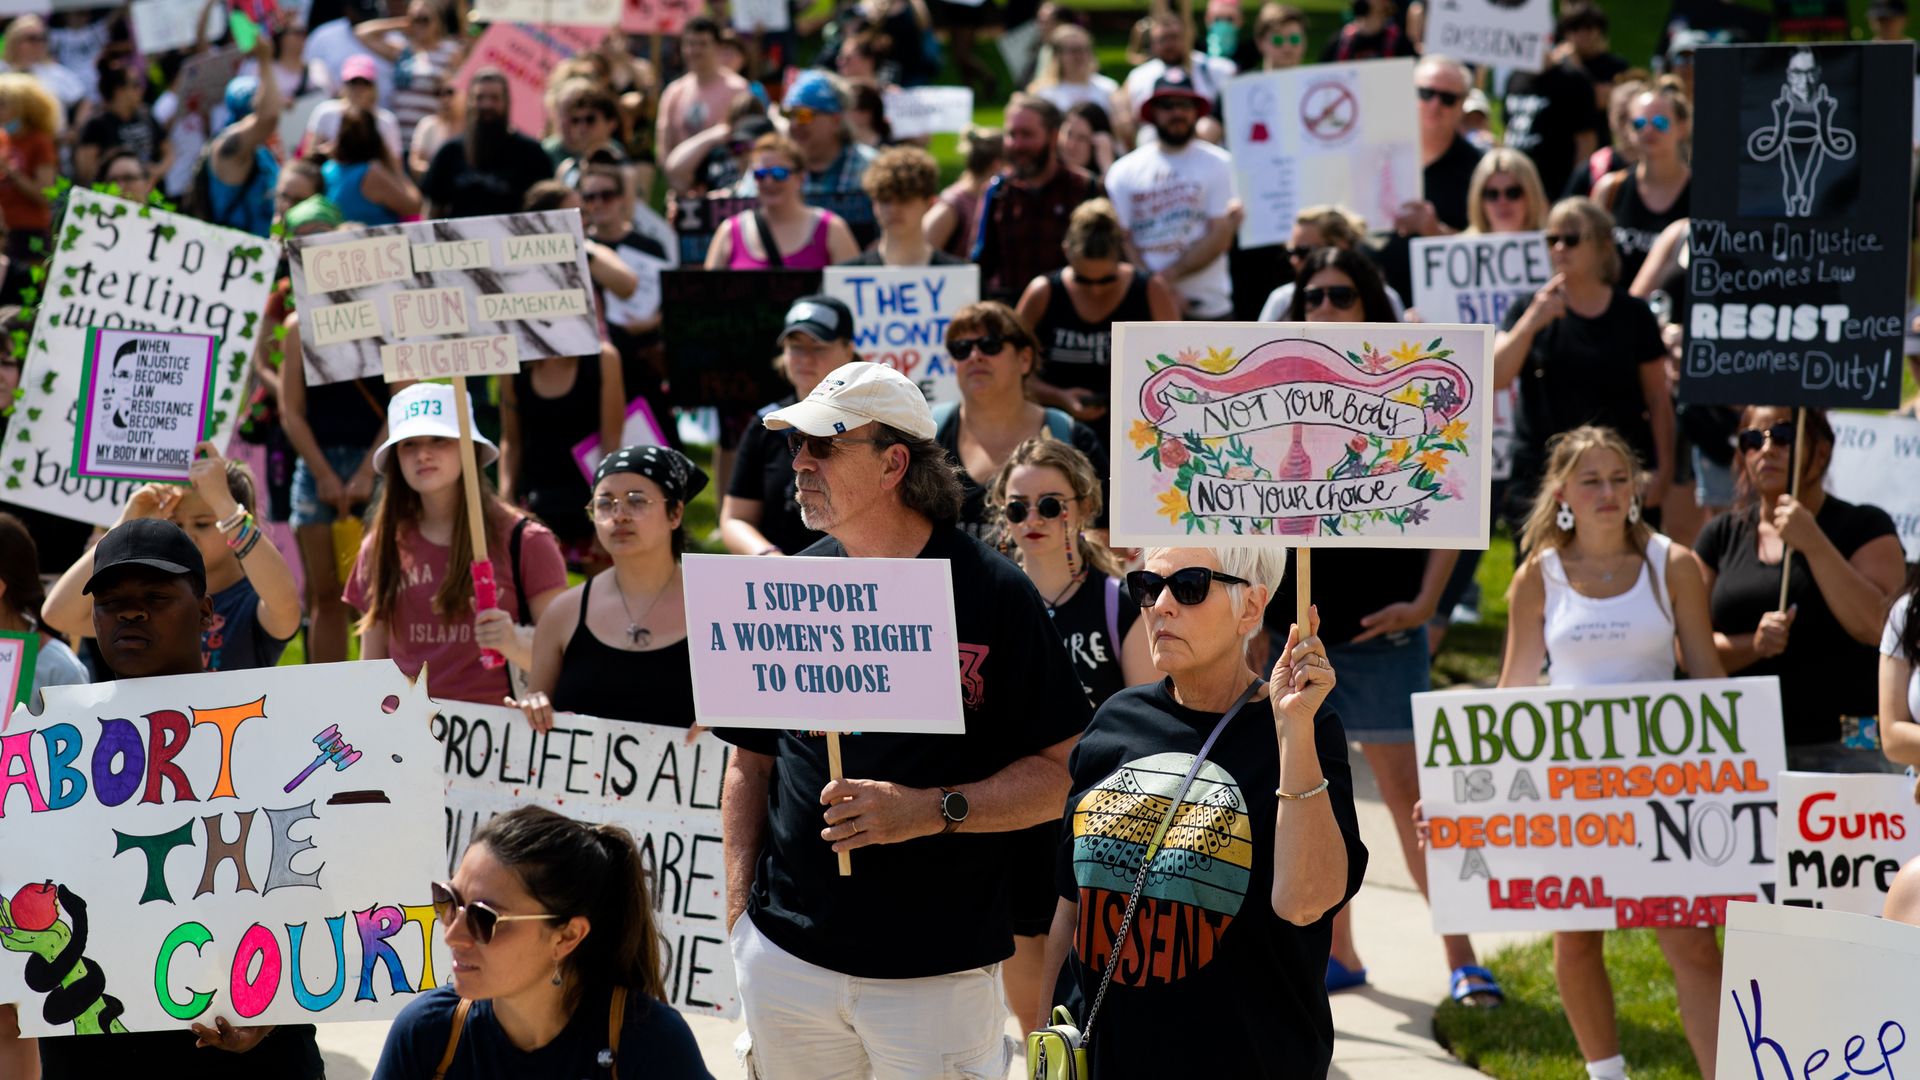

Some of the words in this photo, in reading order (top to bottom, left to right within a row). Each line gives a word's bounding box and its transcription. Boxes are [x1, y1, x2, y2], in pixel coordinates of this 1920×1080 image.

[93, 211, 248, 292] Stop
[422, 240, 484, 271] JUST
[507, 238, 570, 261] WANNA
[1690, 218, 1765, 257] When
[1773, 222, 1884, 262] Injustice
[1423, 239, 1548, 288] FORCE
[1691, 258, 1811, 297] Becomes
[1818, 260, 1856, 282] Law
[79, 261, 234, 346] telling
[313, 303, 376, 339] HAVE
[393, 291, 465, 334] FUN
[484, 294, 580, 319] DAMENTAL
[843, 276, 946, 317] THEY
[136, 354, 191, 371] INJUSTICE
[139, 339, 170, 354] WHEN
[395, 336, 509, 381] RIGHTS
[134, 369, 184, 386] BECOMES
[1686, 339, 1800, 378] Becomes
[1801, 349, 1892, 400] Duty!
[131, 400, 194, 417] RESISTANCE
[132, 384, 156, 398] LAW
[404, 399, 443, 421] 1973
[1203, 393, 1268, 434] NOT
[1274, 387, 1342, 421] YOUR
[127, 430, 156, 445] DUTY.
[128, 415, 178, 431] BECOMES
[96, 444, 111, 458] MY
[113, 444, 138, 461] BODY
[139, 446, 155, 462] MY
[156, 448, 190, 464] CHOICE
[1198, 480, 1251, 512] NOT
[1253, 483, 1314, 515] YOUR
[745, 581, 758, 610] I
[763, 582, 878, 612] SUPPORT
[409, 623, 471, 643] ISLAND
[711, 622, 727, 651] A
[733, 622, 845, 653] WOMEN'S
[852, 624, 933, 652] RIGHT
[752, 664, 787, 692] TO
[794, 664, 891, 693] CHOOSE
[1424, 691, 1747, 768] ABORTION
[0, 694, 269, 819] ABORT
[601, 732, 640, 797] IS
[647, 741, 682, 802] A
[1452, 768, 1496, 804] IS
[1508, 768, 1540, 801] A
[1547, 759, 1770, 800] PERSONAL
[1647, 799, 1778, 867] NOT
[1798, 791, 1907, 842] Guns
[112, 799, 326, 905] THE
[1459, 848, 1492, 880] A
[1487, 875, 1614, 911] LEGAL
[154, 902, 444, 1020] COURT
[1731, 978, 1906, 1080] Keep
